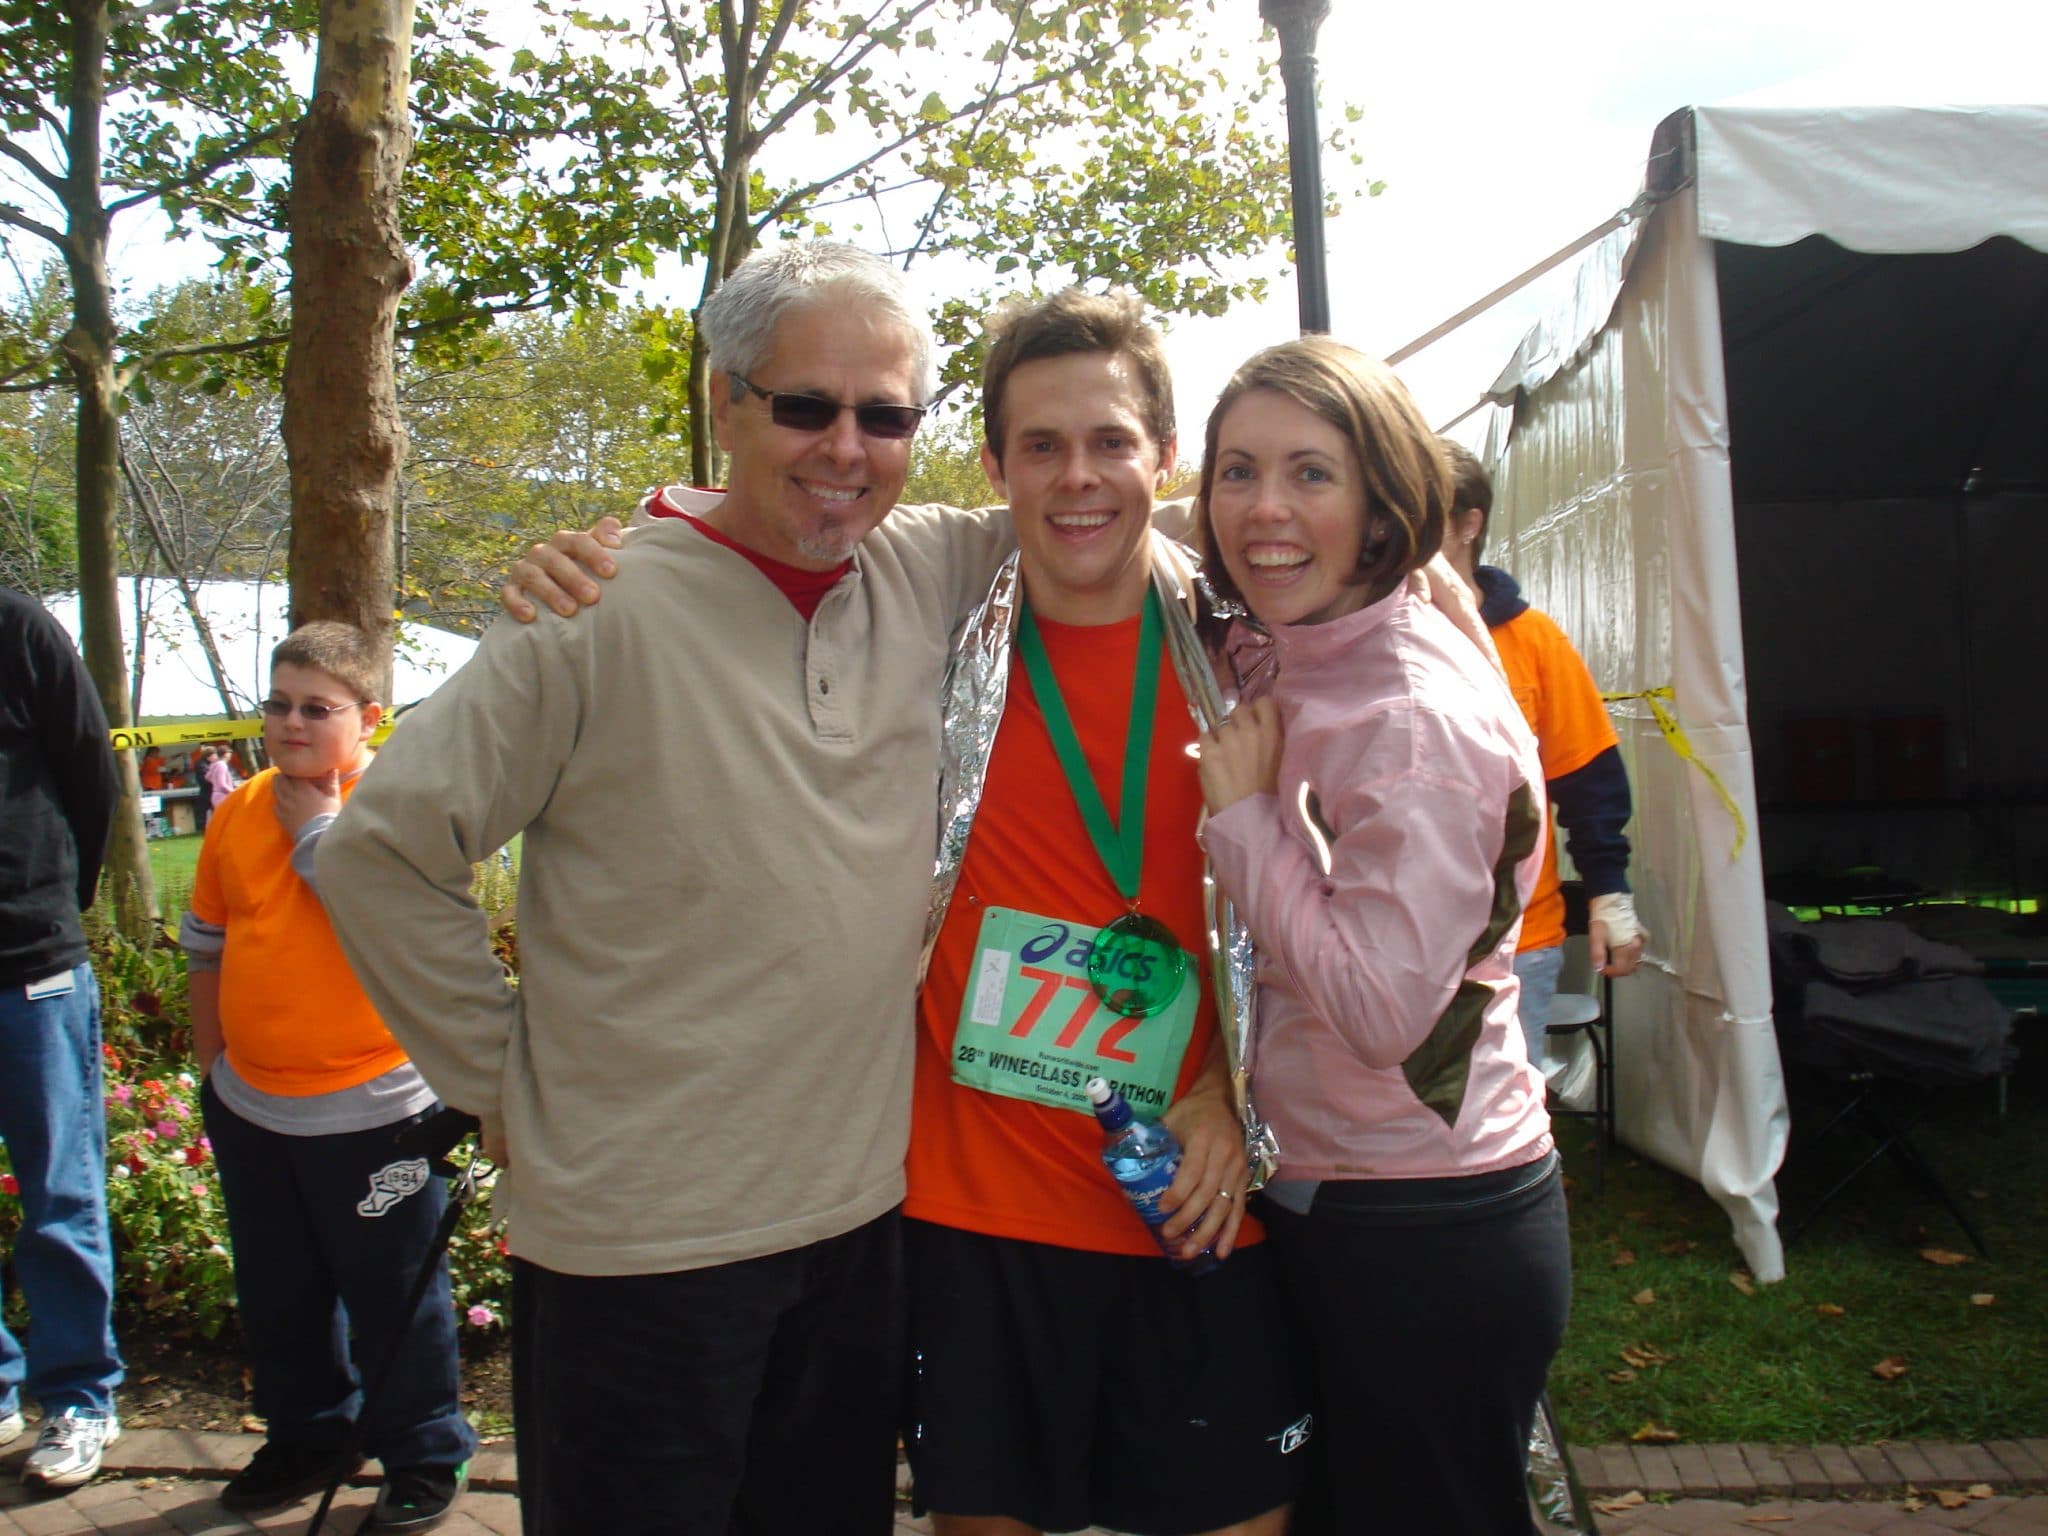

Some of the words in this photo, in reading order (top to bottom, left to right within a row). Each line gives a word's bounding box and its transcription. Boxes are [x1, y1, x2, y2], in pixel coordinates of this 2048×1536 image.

[1009, 966, 1144, 1064] 772
[957, 1045, 985, 1064] 28th
[989, 1051, 1081, 1088] WINEGLASS
[1086, 1074, 1166, 1106] RATHON
